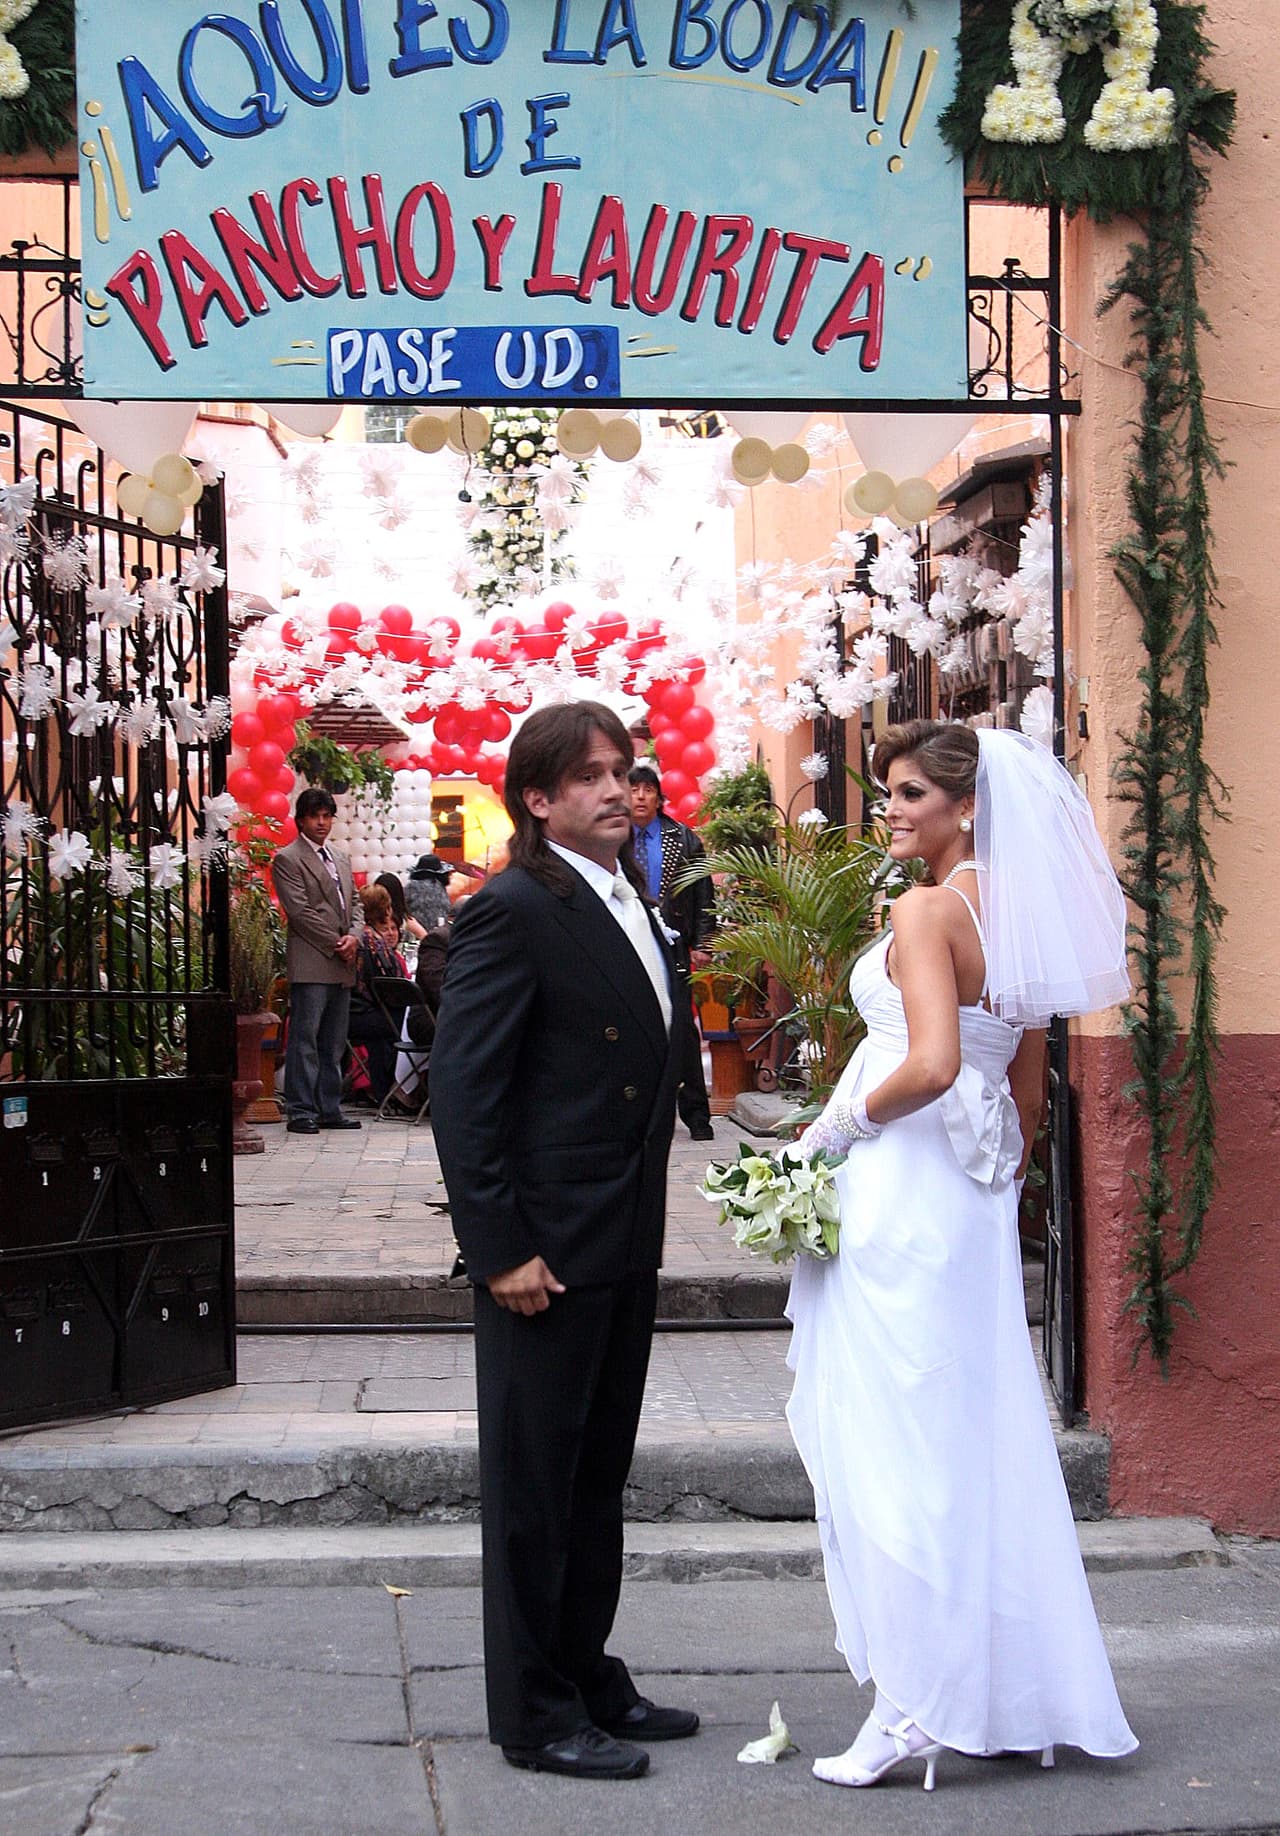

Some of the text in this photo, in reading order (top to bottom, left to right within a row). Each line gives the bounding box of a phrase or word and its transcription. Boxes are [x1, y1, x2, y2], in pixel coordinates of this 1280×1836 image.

[460, 92, 582, 177] DE
[472, 213, 517, 292] Y
[330, 326, 600, 396] PASE UD.
[159, 1162, 167, 1177] 3
[200, 1158, 208, 1173] 4
[42, 1171, 49, 1186] 1
[161, 1307, 169, 1322] 9
[198, 1301, 209, 1317] 10
[15, 1328, 23, 1343] 7
[61, 1320, 71, 1336] 8
